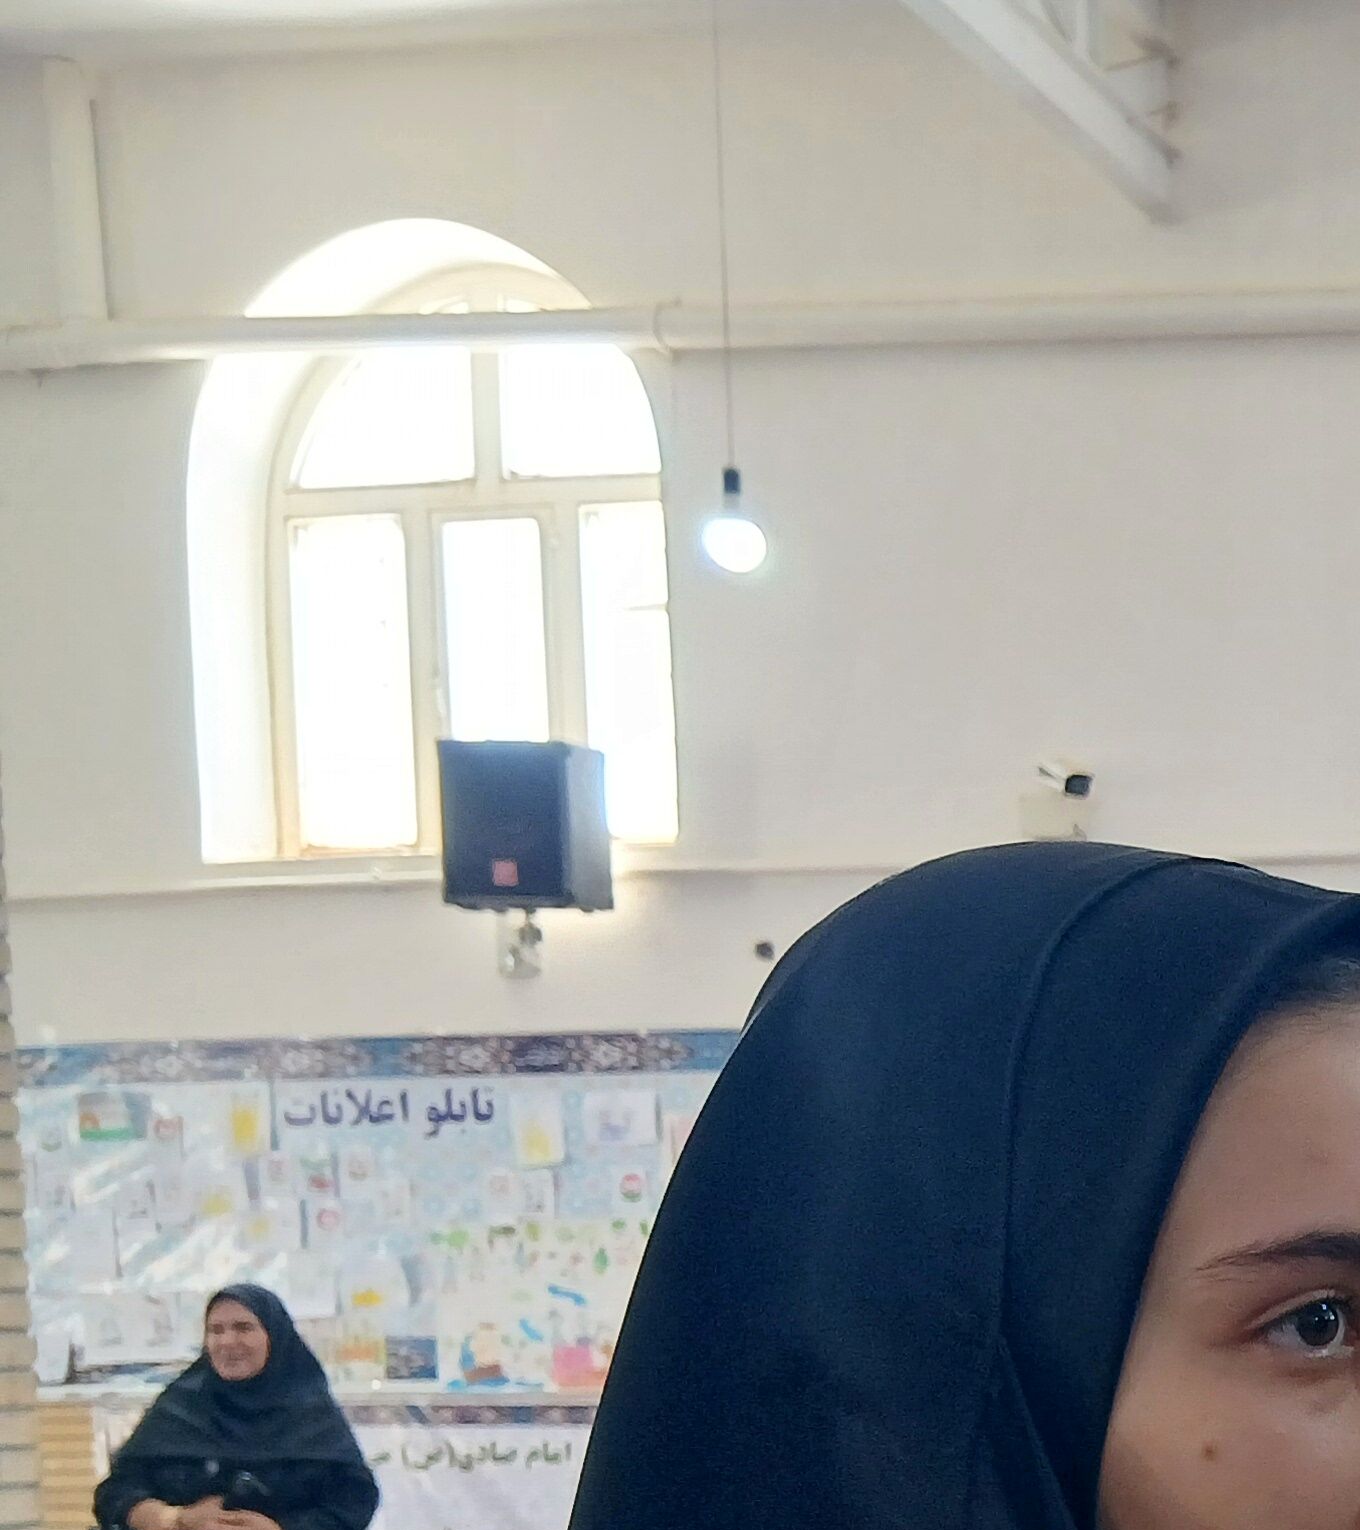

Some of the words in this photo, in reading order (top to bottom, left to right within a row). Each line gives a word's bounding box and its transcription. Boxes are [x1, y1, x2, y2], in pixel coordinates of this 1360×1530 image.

[284, 1088, 410, 1126] اعلانات
[423, 1086, 494, 1141] تابلو
[525, 1442, 572, 1471] امام
